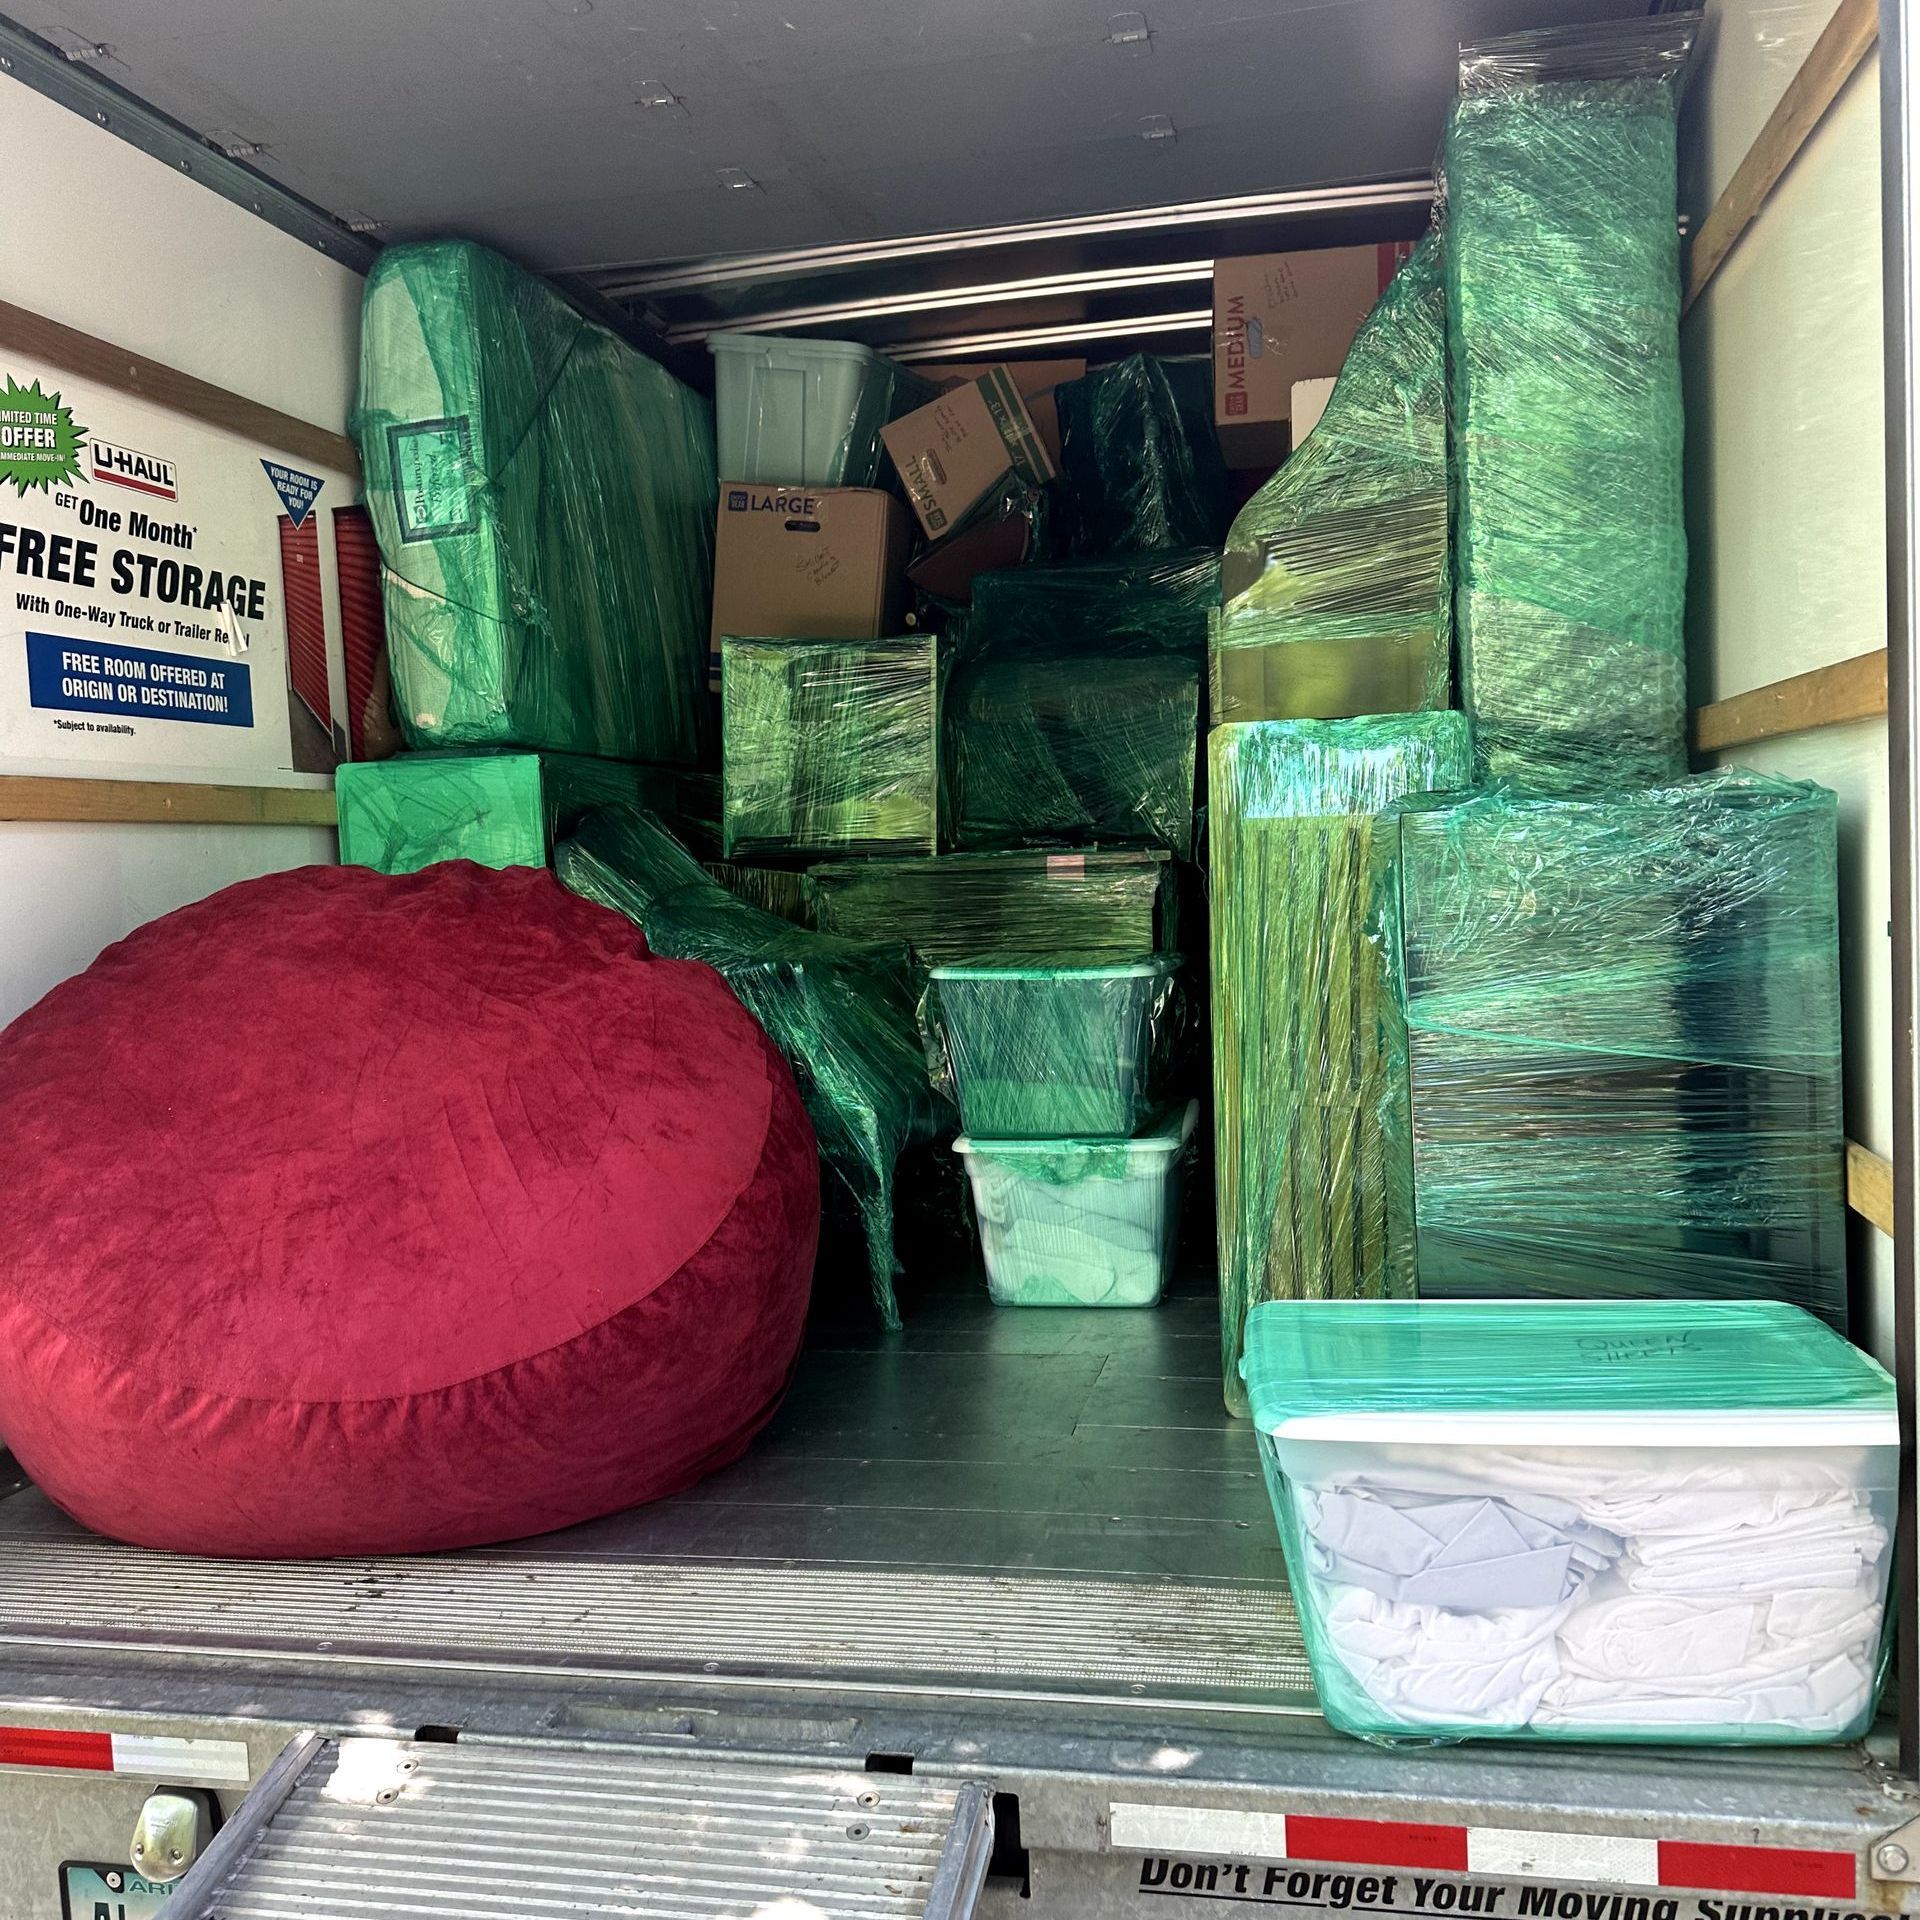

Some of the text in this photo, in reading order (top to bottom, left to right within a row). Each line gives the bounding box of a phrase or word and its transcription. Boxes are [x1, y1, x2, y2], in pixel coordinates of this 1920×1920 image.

[1227, 295, 1245, 390] MEDIUM
[0, 410, 57, 425] IMITED TIME
[1, 425, 56, 448] OFFER
[0, 452, 36, 462] MMEDIATE
[94, 443, 174, 487] U-HAUL
[271, 466, 318, 491] YOUR ROOM IS
[277, 480, 313, 501] READY FOR
[905, 455, 938, 511] SMALL
[55, 492, 79, 510] GET
[79, 498, 121, 533] One
[289, 496, 304, 510] YOU!
[751, 495, 814, 514] LARGE
[0, 522, 266, 621] FREE STORAGE
[16, 592, 250, 646] With One-Way Truck or Trailer Rel
[62, 651, 225, 690] FREE ROOM OFFERED AT
[62, 677, 229, 713] ORIGIN OR DESTINATION!
[86, 722, 94, 732] to
[96, 723, 136, 737] availability.
[1139, 1857, 1250, 1893] Don't
[1262, 1867, 1398, 1909] Forget
[1413, 1878, 1505, 1914] Your
[1518, 1886, 1679, 1920] Moving
